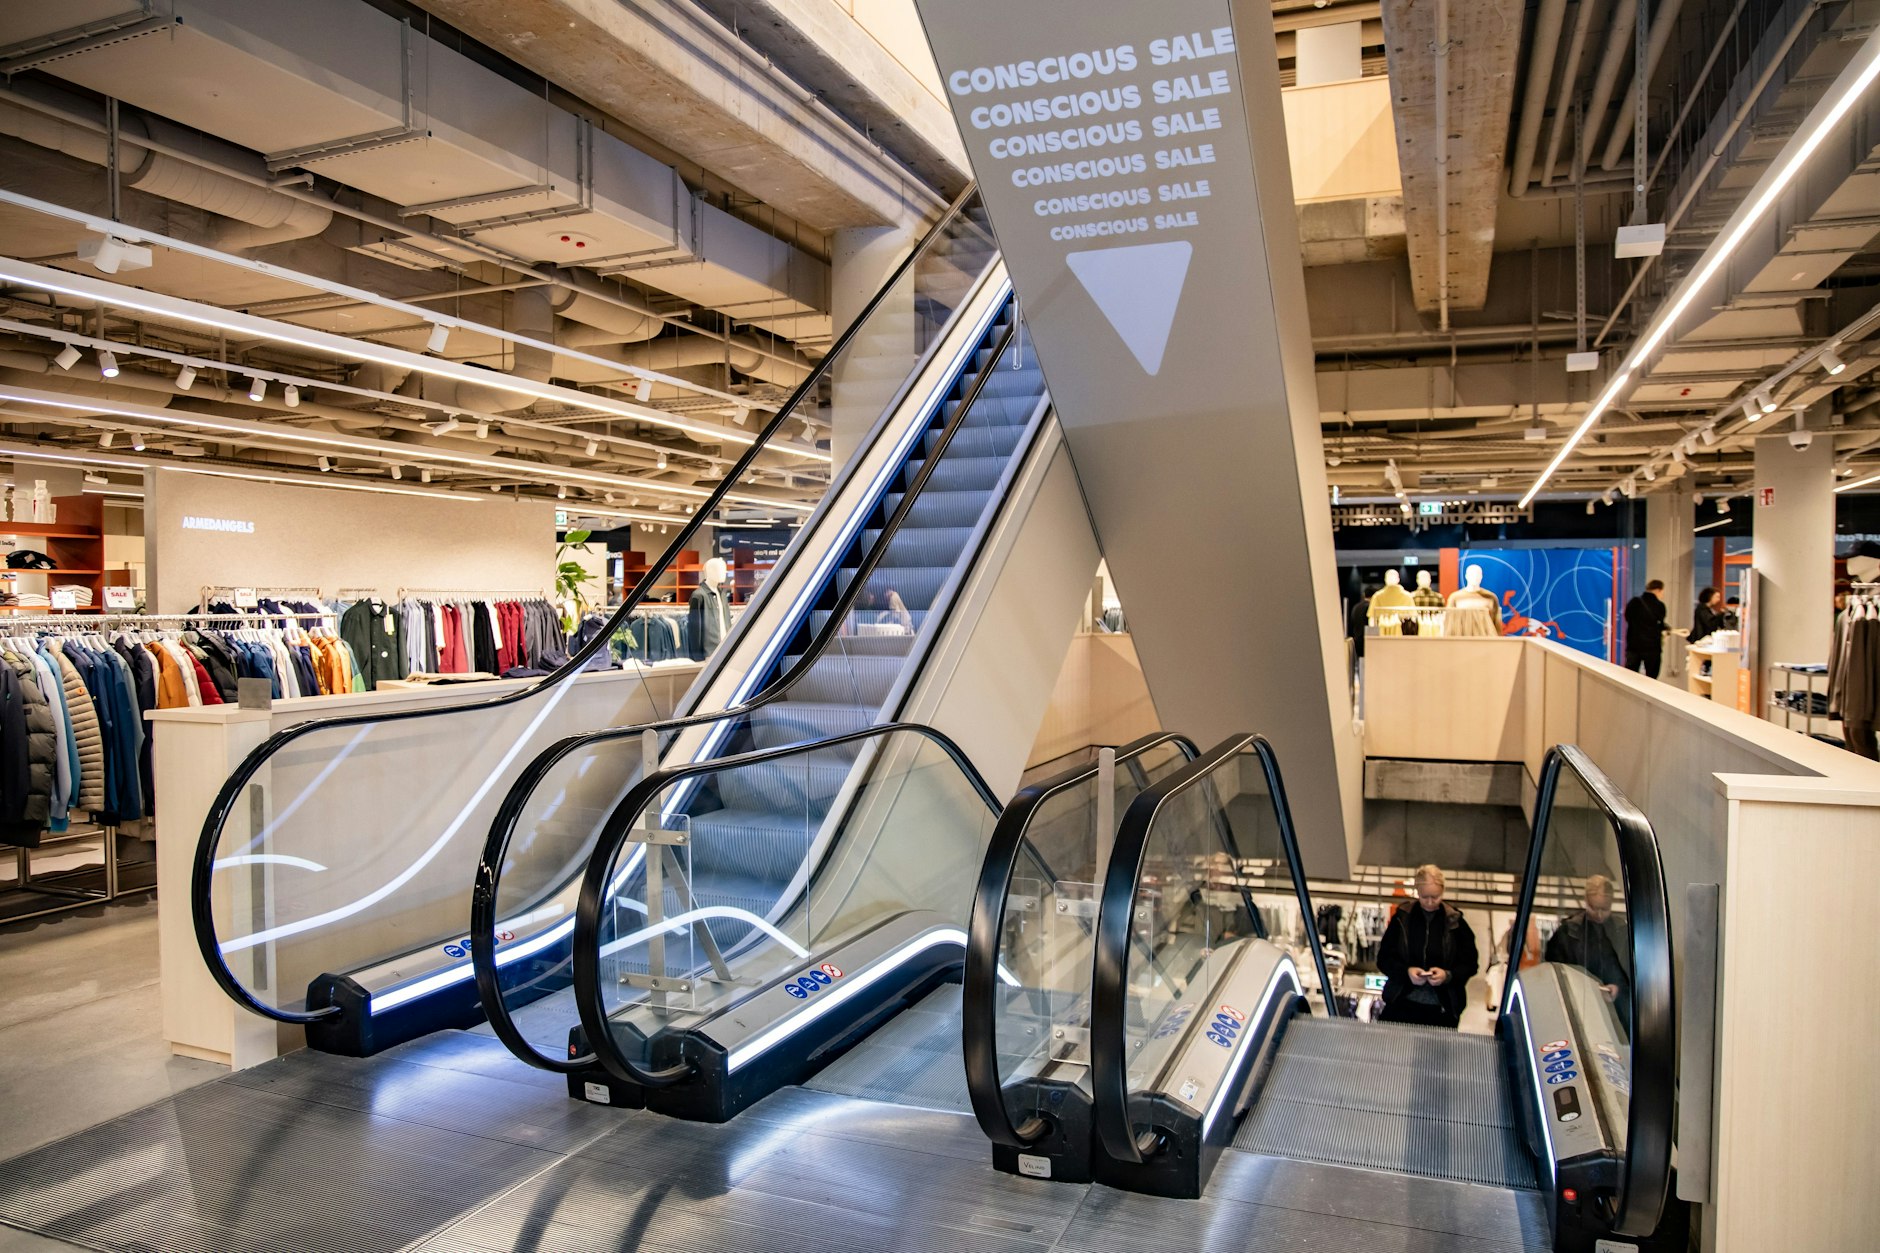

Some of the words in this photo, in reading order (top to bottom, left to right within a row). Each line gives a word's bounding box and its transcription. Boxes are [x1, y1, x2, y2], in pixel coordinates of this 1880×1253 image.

[950, 45, 1137, 95] CONSCIOUS
[1150, 27, 1235, 65] SALE
[971, 85, 1141, 129] CONSCIOUS
[1152, 70, 1229, 104] SALE
[989, 120, 1142, 159] CONSCIOUS
[1152, 108, 1220, 136] SALE
[1012, 154, 1146, 187] CONSCIOUS
[1155, 144, 1214, 168] SALE
[1034, 188, 1150, 216] CONSCIOUS
[1159, 181, 1209, 201] SALE
[1051, 218, 1148, 241] CONSCIOUS
[1155, 212, 1197, 229] SALE
[182, 516, 255, 534] ARMEDANGELS
